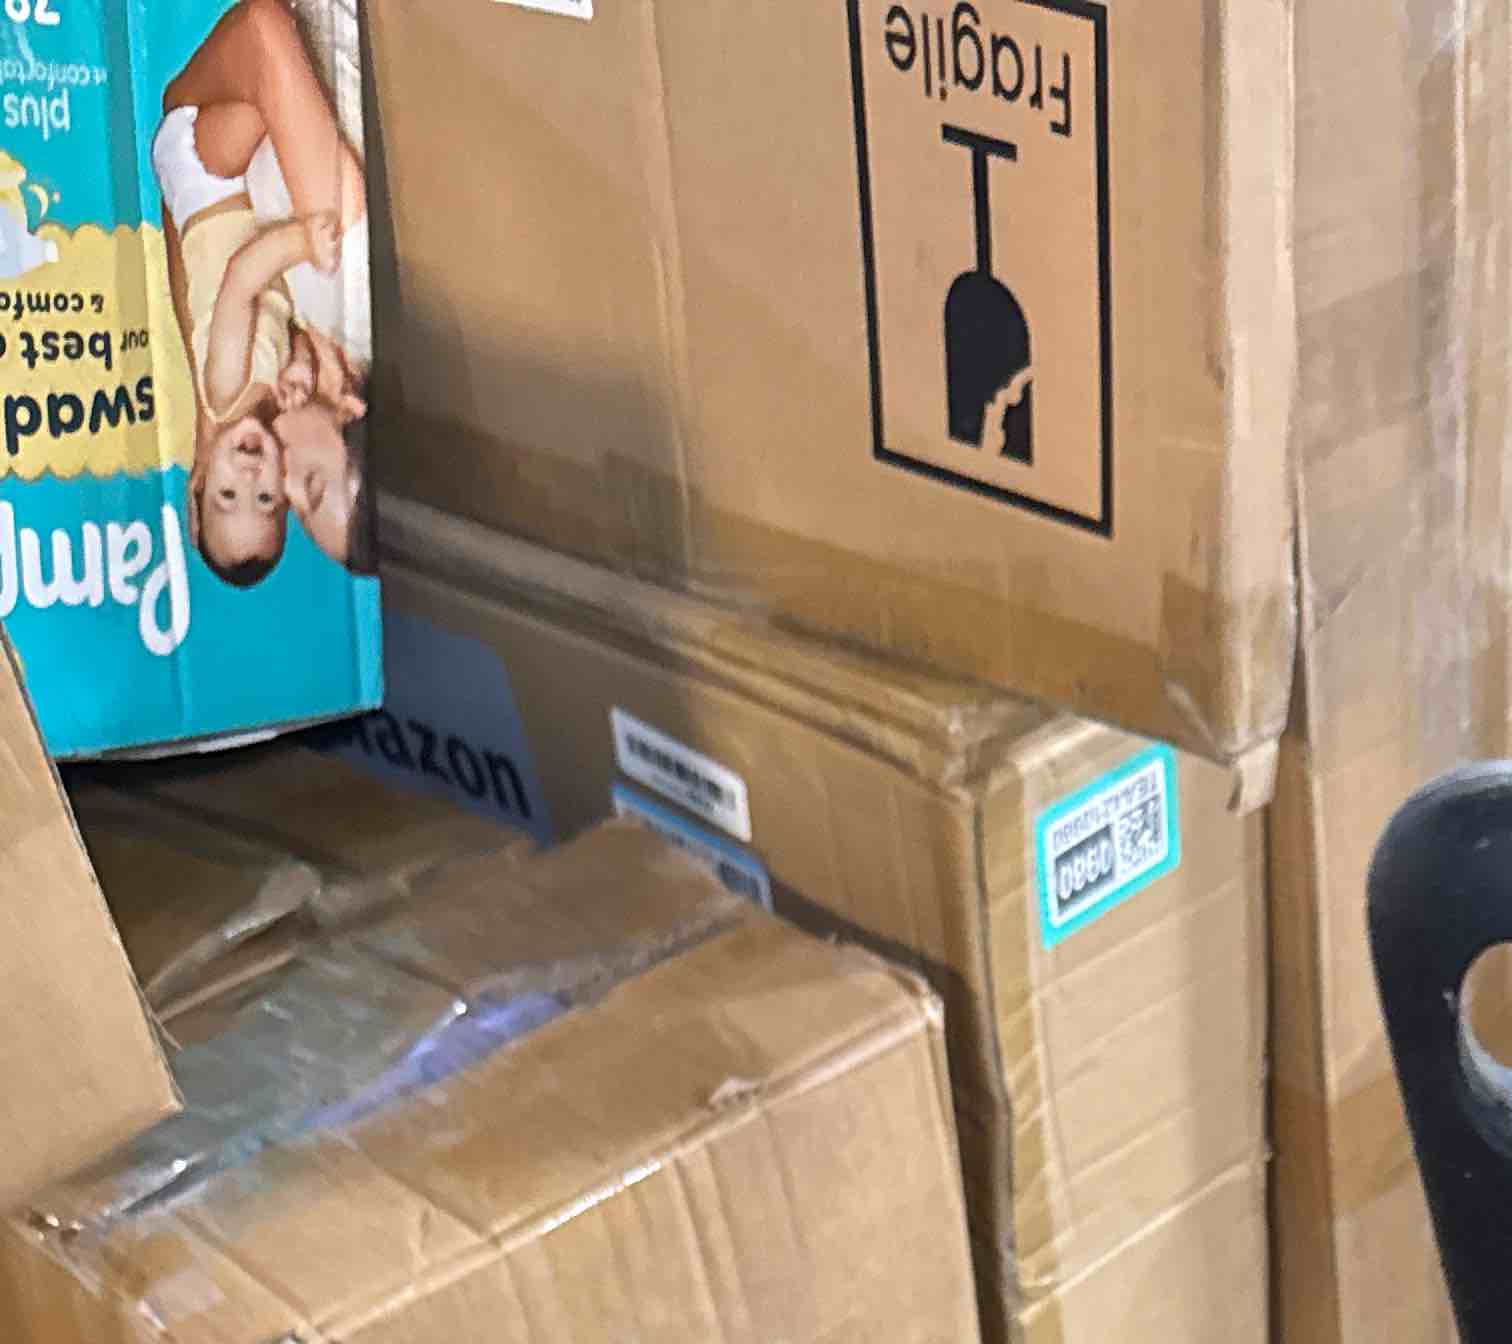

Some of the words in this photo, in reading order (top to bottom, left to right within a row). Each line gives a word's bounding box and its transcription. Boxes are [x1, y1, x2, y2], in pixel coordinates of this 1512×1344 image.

[884, 2, 1072, 138] Fragile
[3, 86, 71, 142] plus
[19, 329, 113, 371] best
[120, 328, 149, 352] our
[358, 709, 532, 819] azon
[1056, 836, 1113, 901] 0980
